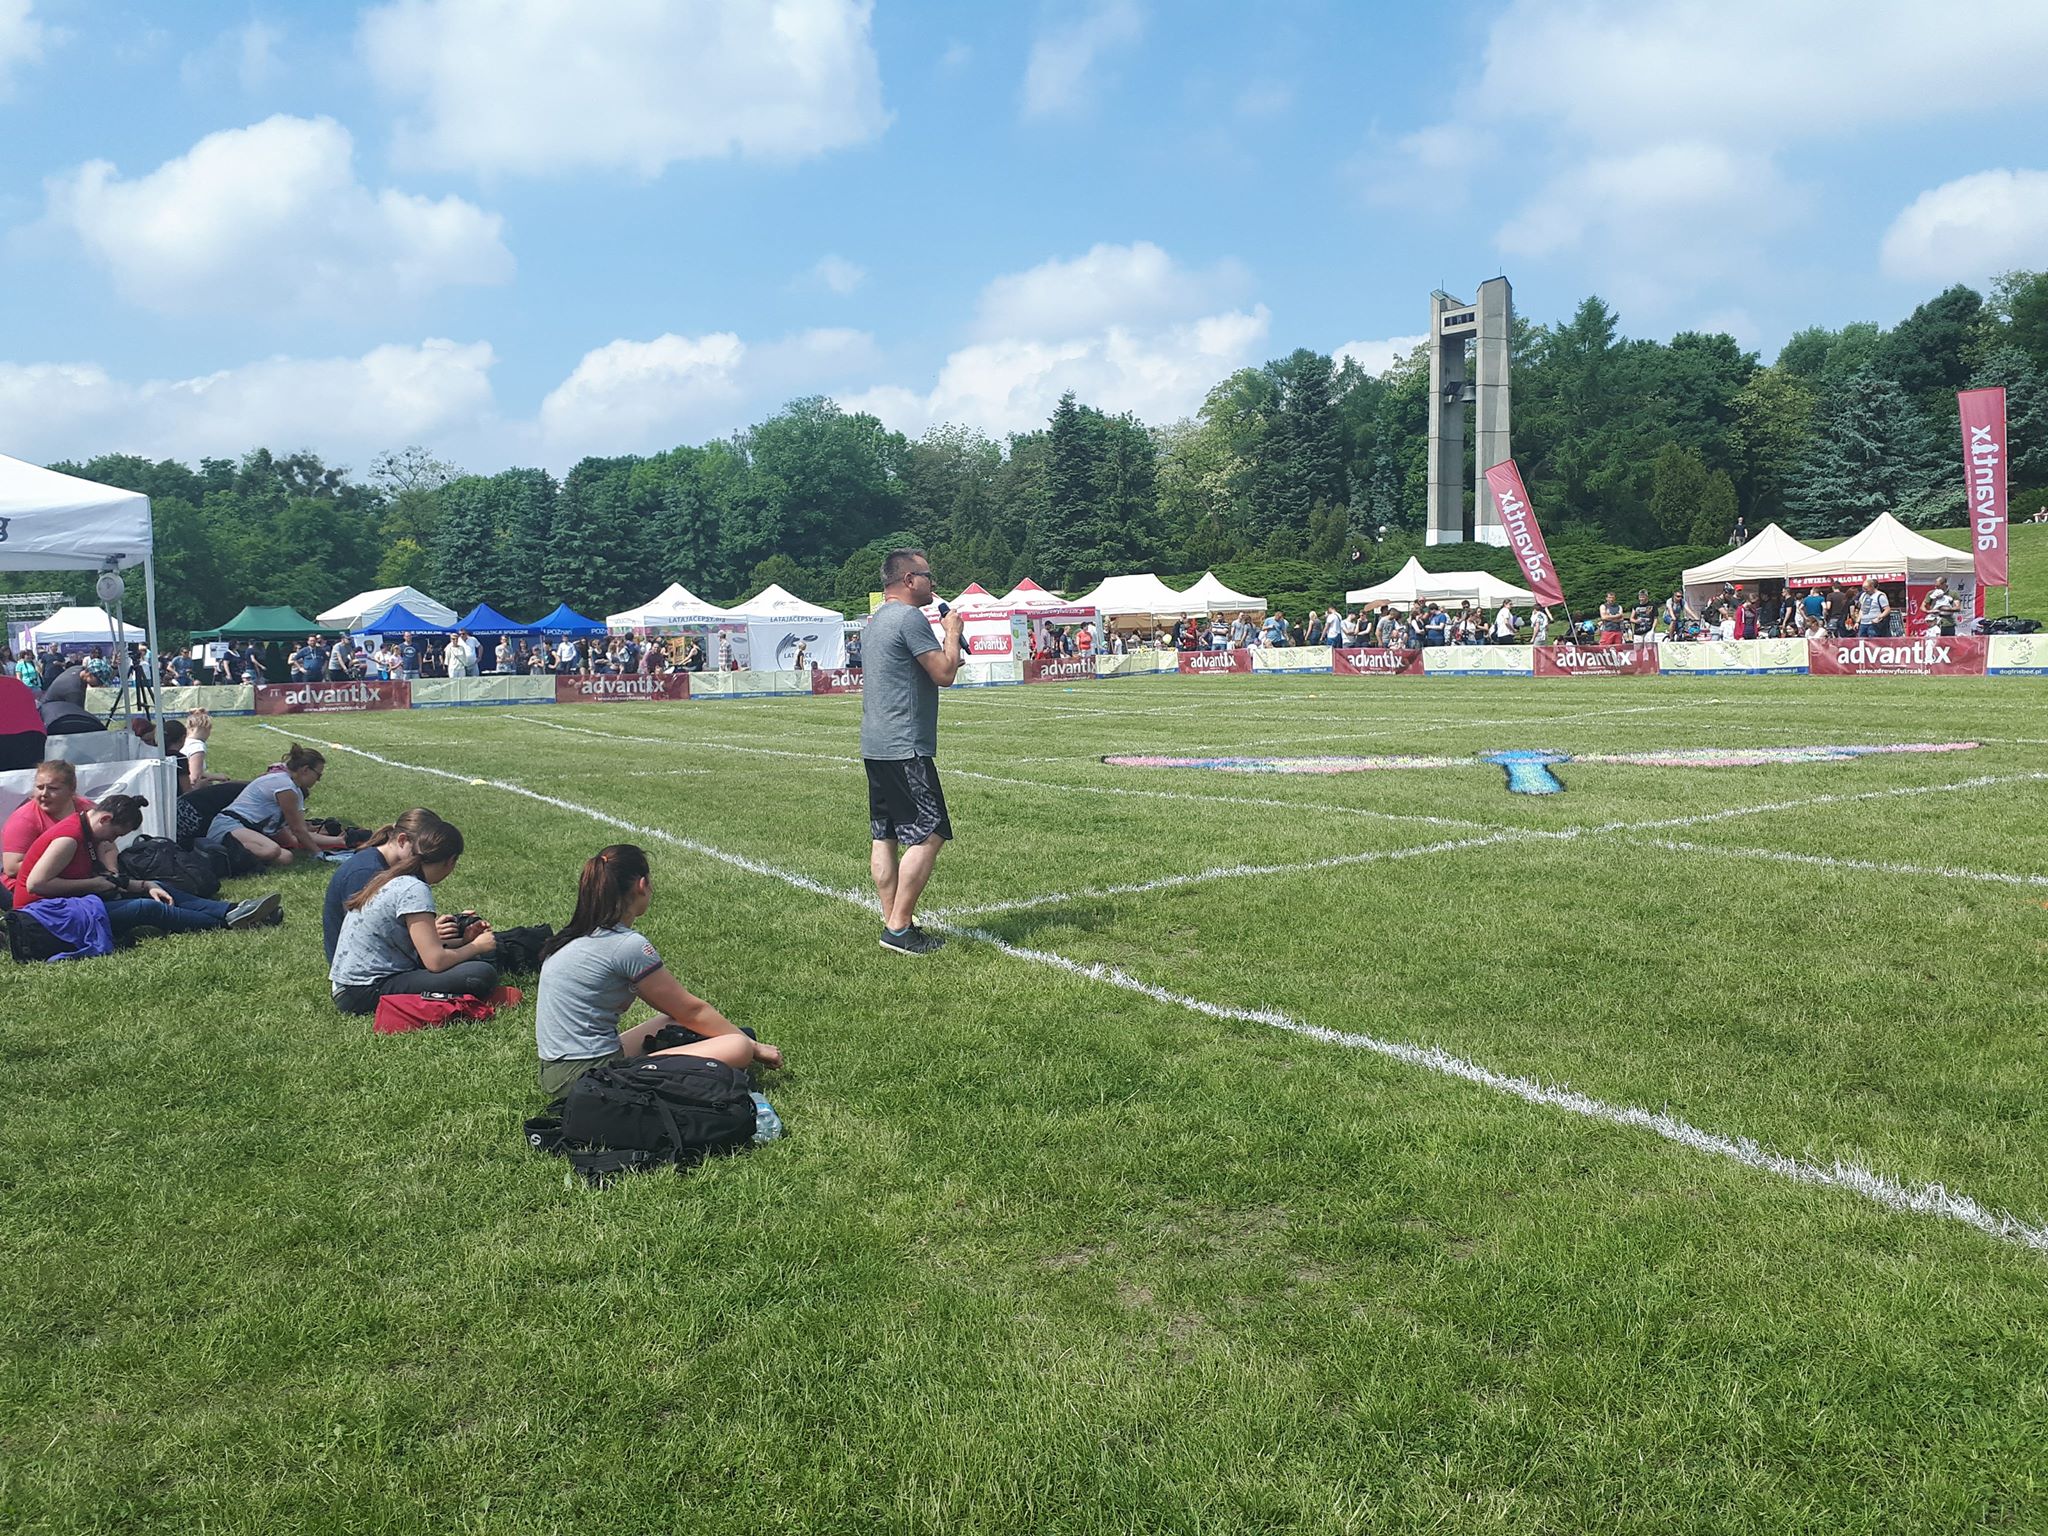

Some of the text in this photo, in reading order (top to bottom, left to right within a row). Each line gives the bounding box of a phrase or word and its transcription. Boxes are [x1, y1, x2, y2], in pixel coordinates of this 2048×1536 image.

[973, 638, 1008, 651] advantix
[1838, 639, 1951, 665] advantix
[1190, 652, 1236, 668] advantix
[1347, 649, 1406, 669] advantix
[1556, 647, 1633, 668] advantix
[285, 683, 381, 705] advantix
[581, 676, 665, 695] advantix
